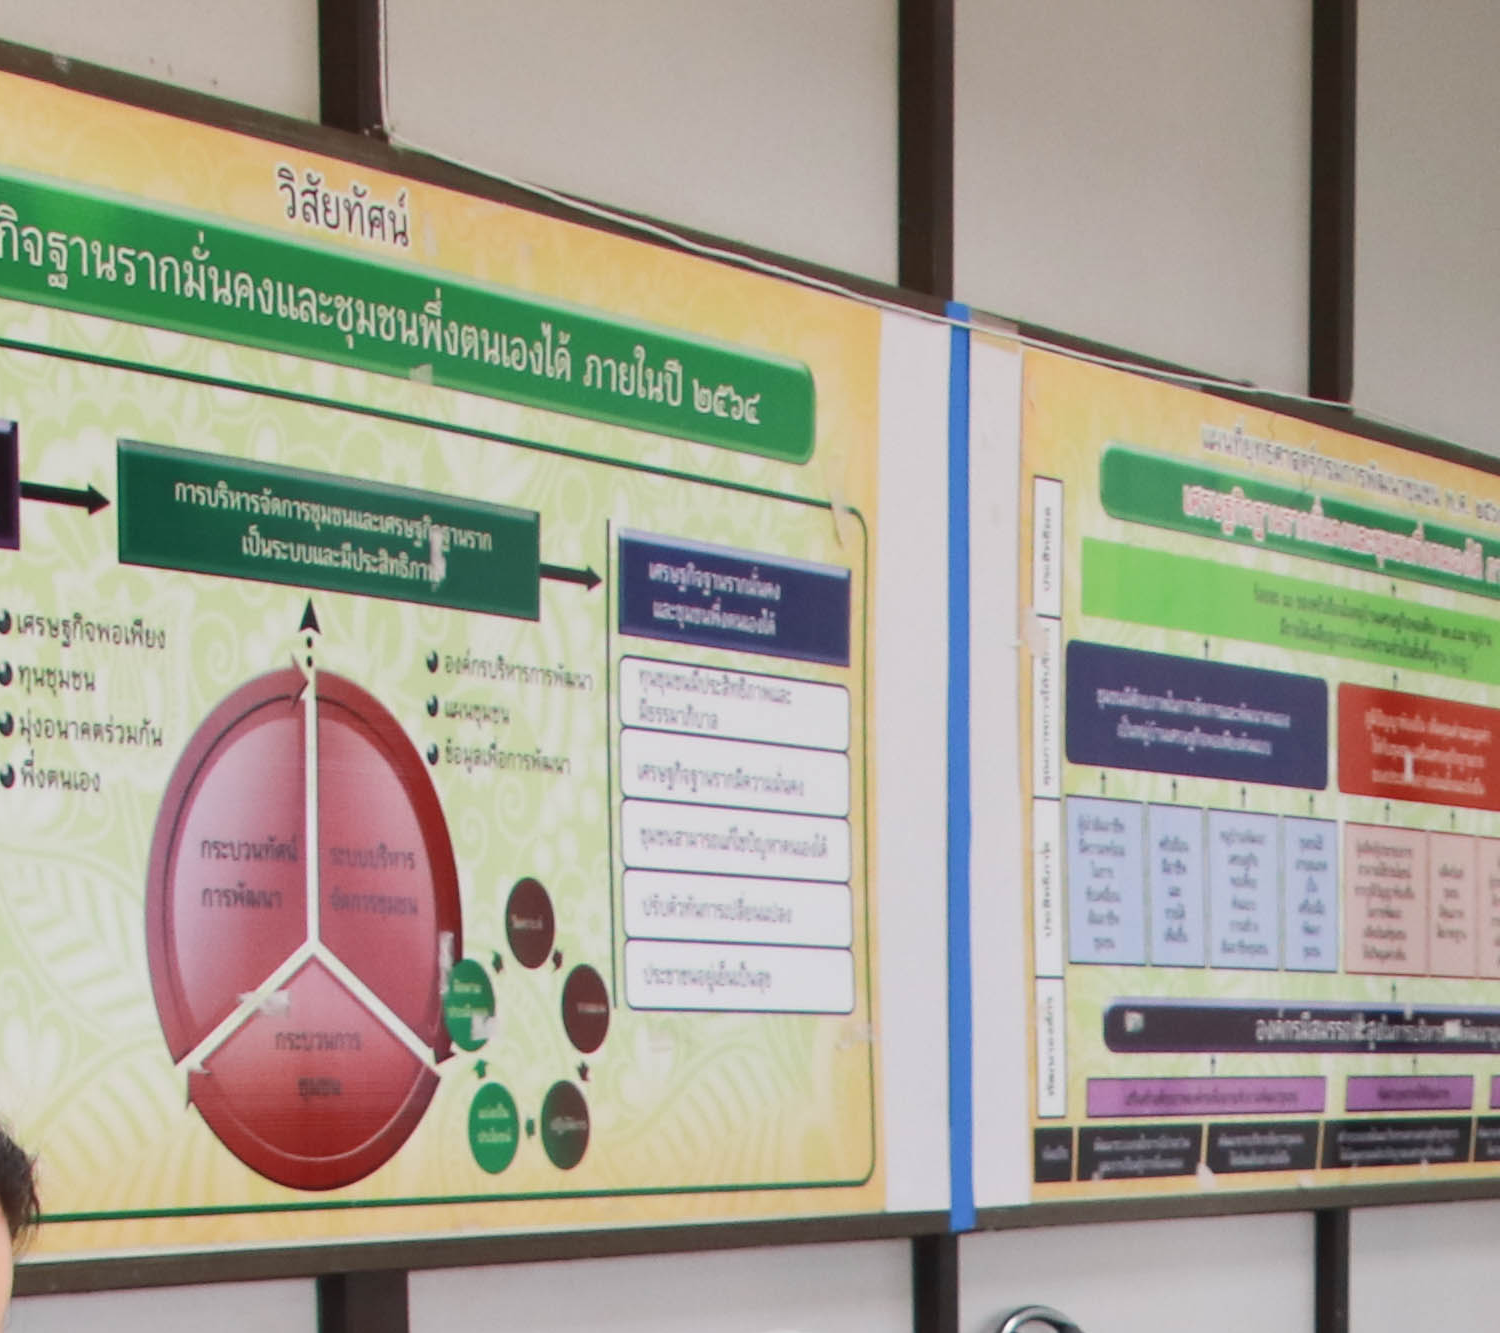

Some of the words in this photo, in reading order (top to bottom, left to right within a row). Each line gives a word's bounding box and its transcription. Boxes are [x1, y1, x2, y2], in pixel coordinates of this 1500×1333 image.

[277, 165, 410, 248] วิสัยทัศน์
[583, 346, 683, 407] ภายในปี
[692, 379, 761, 425] ๒๕๖๔
[174, 480, 493, 554] การบริหารจัดการชุมชนและเศรษฐกิฐานราก
[16, 611, 166, 650] เศรษฐกิจพอเพียง
[18, 664, 96, 698] ทุนชุมชน
[19, 707, 164, 748] มุ่งอนาคตร่วมกัน
[20, 749, 101, 792] พึ่งตนเอง
